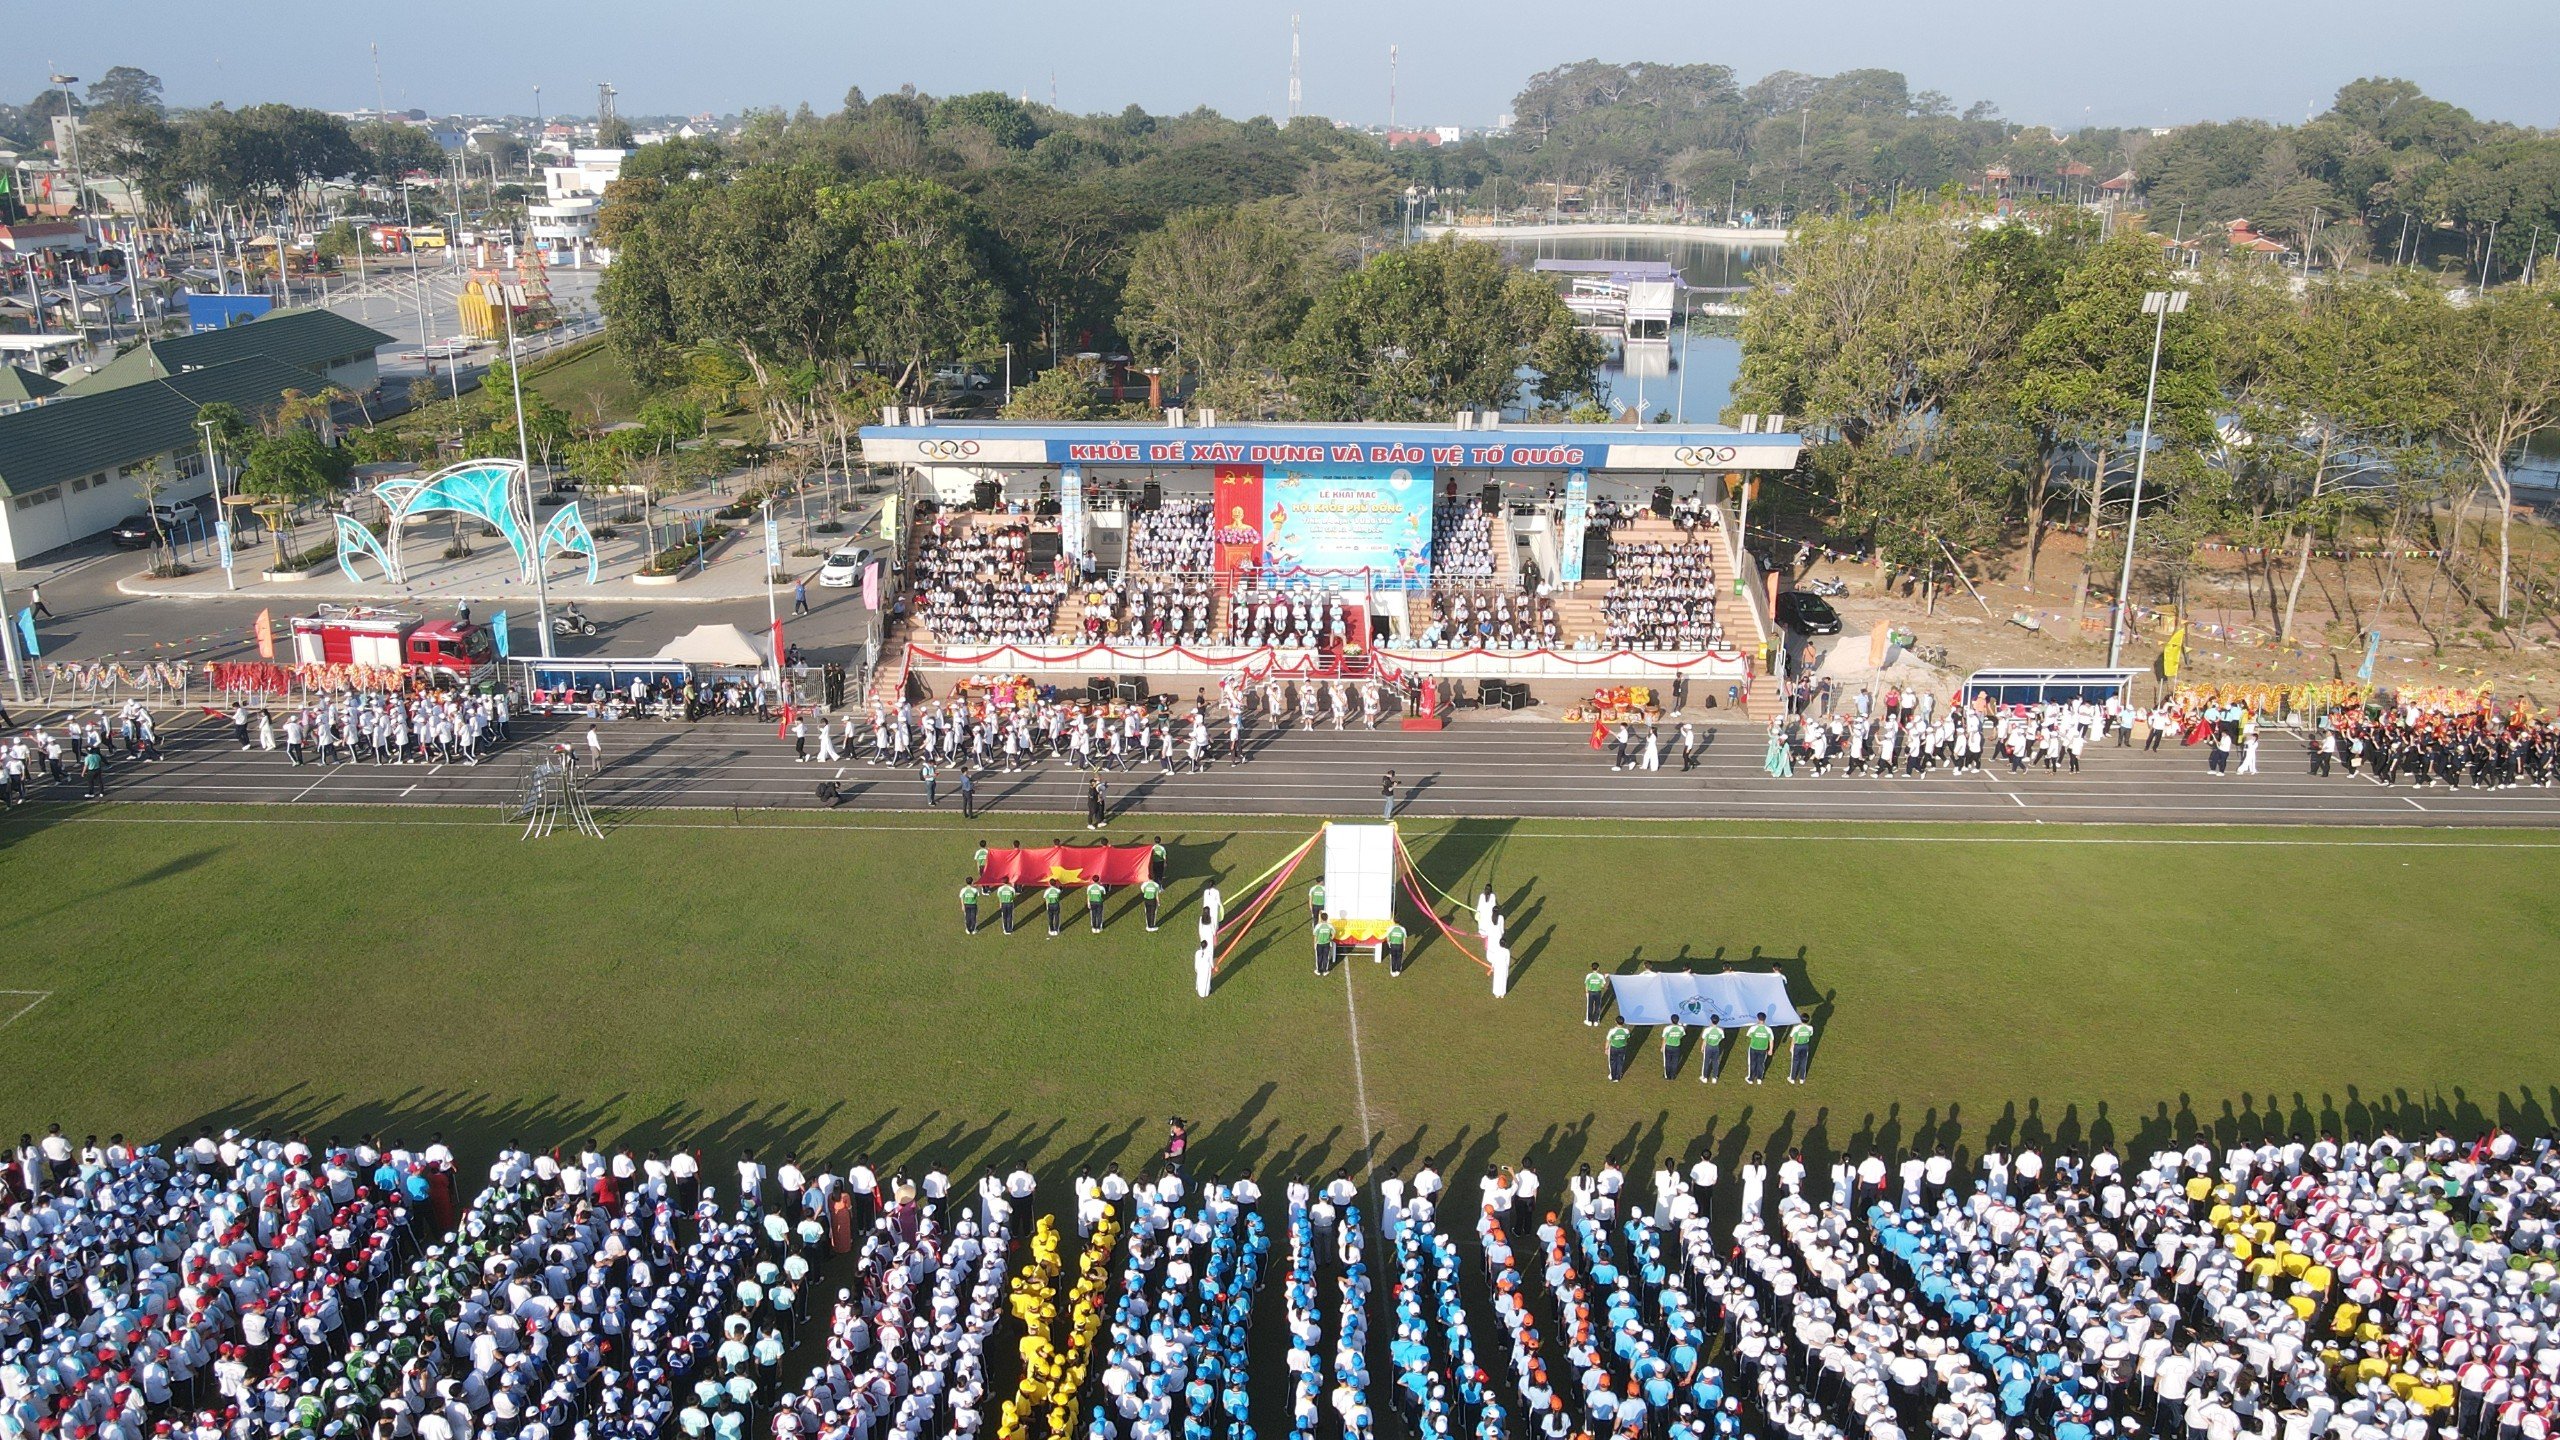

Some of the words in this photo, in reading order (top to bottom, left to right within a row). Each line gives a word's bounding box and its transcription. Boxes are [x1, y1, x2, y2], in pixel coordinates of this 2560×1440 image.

[1070, 441, 1140, 460] KHỎE
[1191, 443, 1245, 461] XÂY
[1251, 444, 1324, 465] DỰNG
[1331, 444, 1363, 462] VÀ
[1370, 443, 1424, 463] BẢO
[1432, 445, 1464, 466] VỆ
[1473, 444, 1507, 464] TỔ
[1512, 444, 1583, 465] QUỐC
